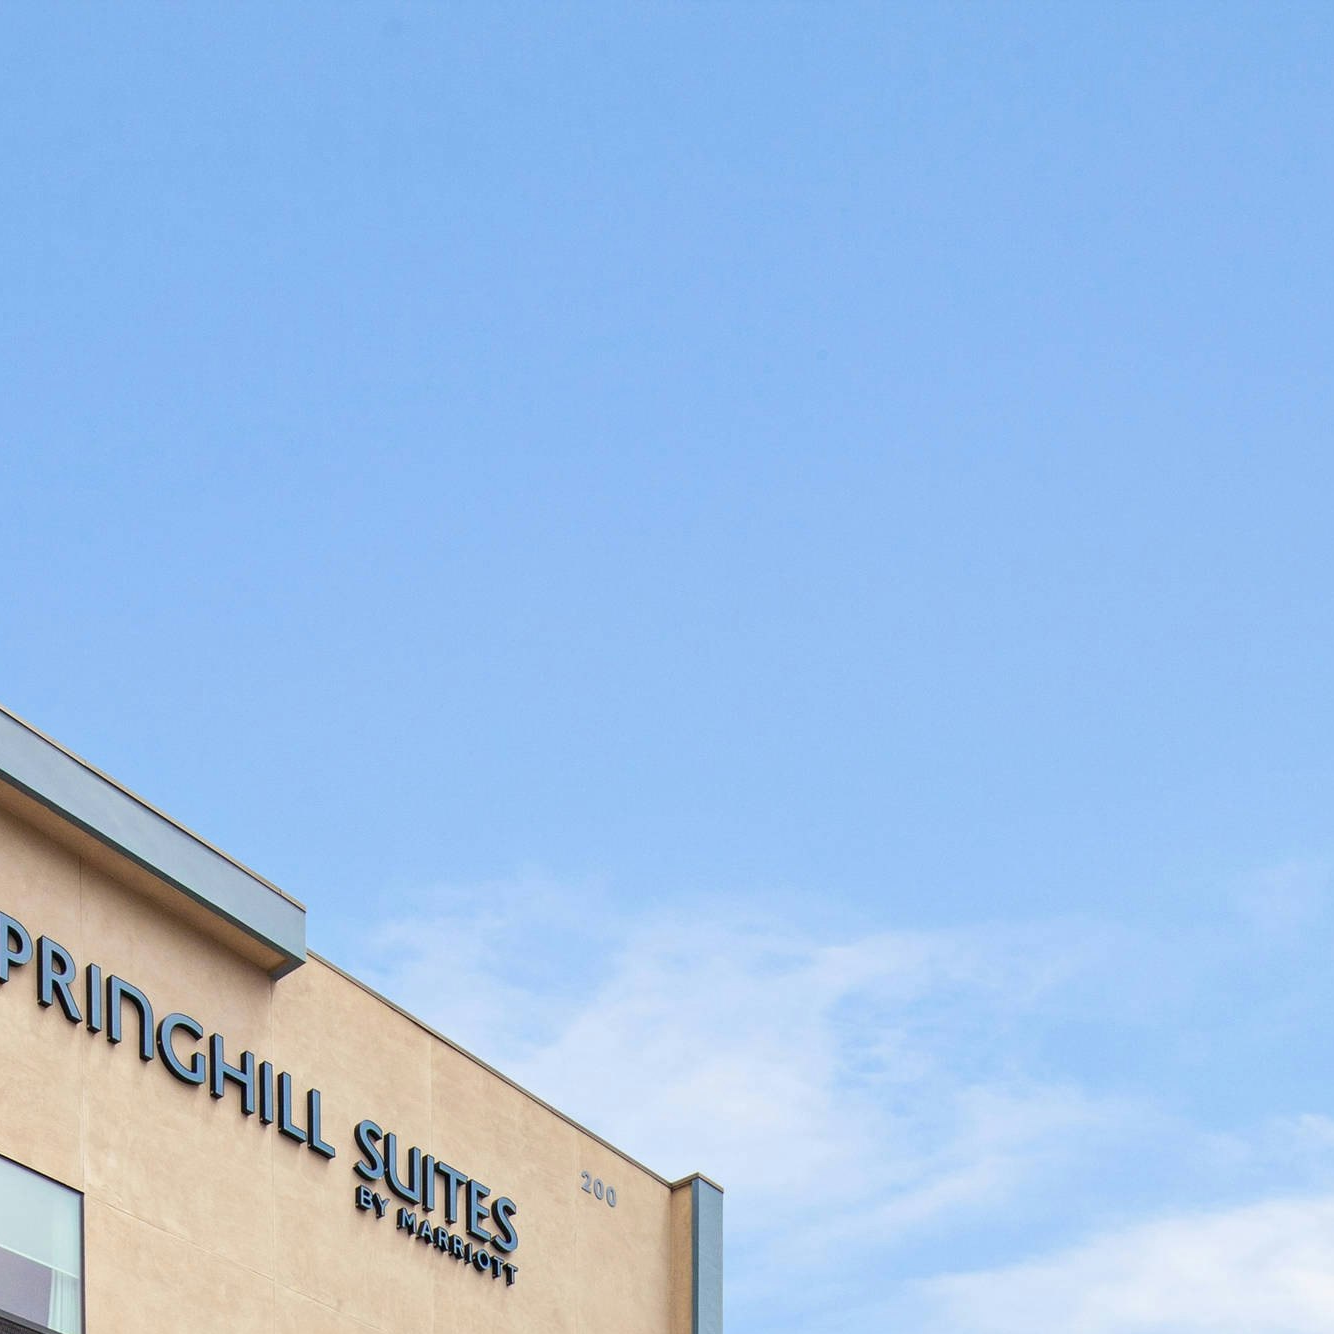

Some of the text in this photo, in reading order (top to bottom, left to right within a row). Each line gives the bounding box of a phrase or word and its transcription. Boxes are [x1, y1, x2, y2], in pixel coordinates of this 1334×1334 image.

[353, 1119, 519, 1253] SUITES
[355, 1184, 518, 1286] BY MARRIOTT
[581, 1170, 616, 1208] 200
